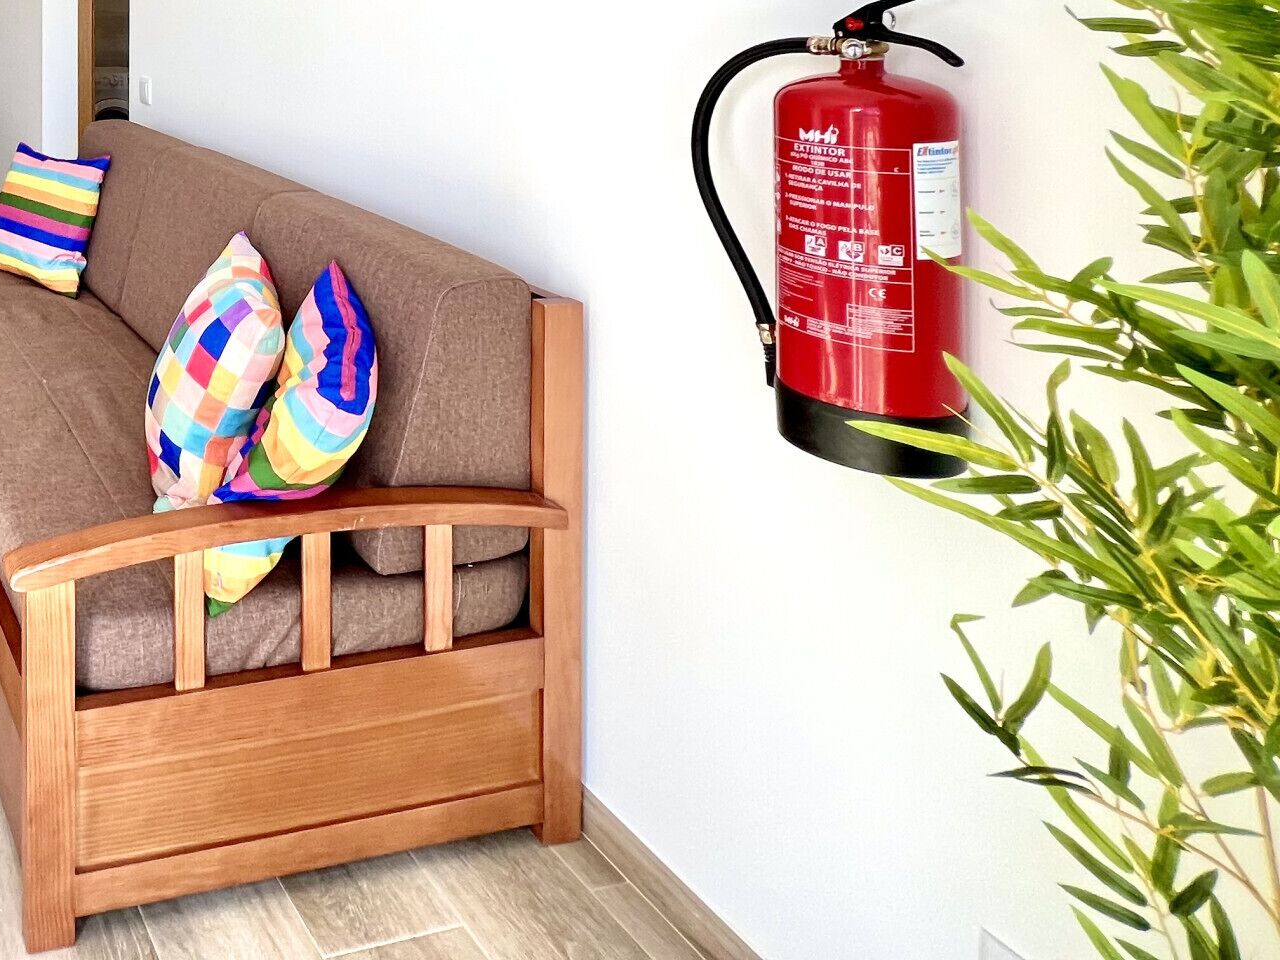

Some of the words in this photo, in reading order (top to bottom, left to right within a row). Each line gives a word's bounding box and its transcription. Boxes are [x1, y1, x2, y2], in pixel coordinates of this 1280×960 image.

[794, 143, 845, 156] EXTINTOR
[792, 164, 814, 174] MODO
[815, 167, 826, 175] DE
[827, 169, 852, 178] USAR
[818, 178, 849, 188] CAVILHA
[817, 222, 837, 230] FOGO
[838, 225, 857, 234] PELA
[859, 228, 880, 236] BASE
[892, 246, 902, 255] C
